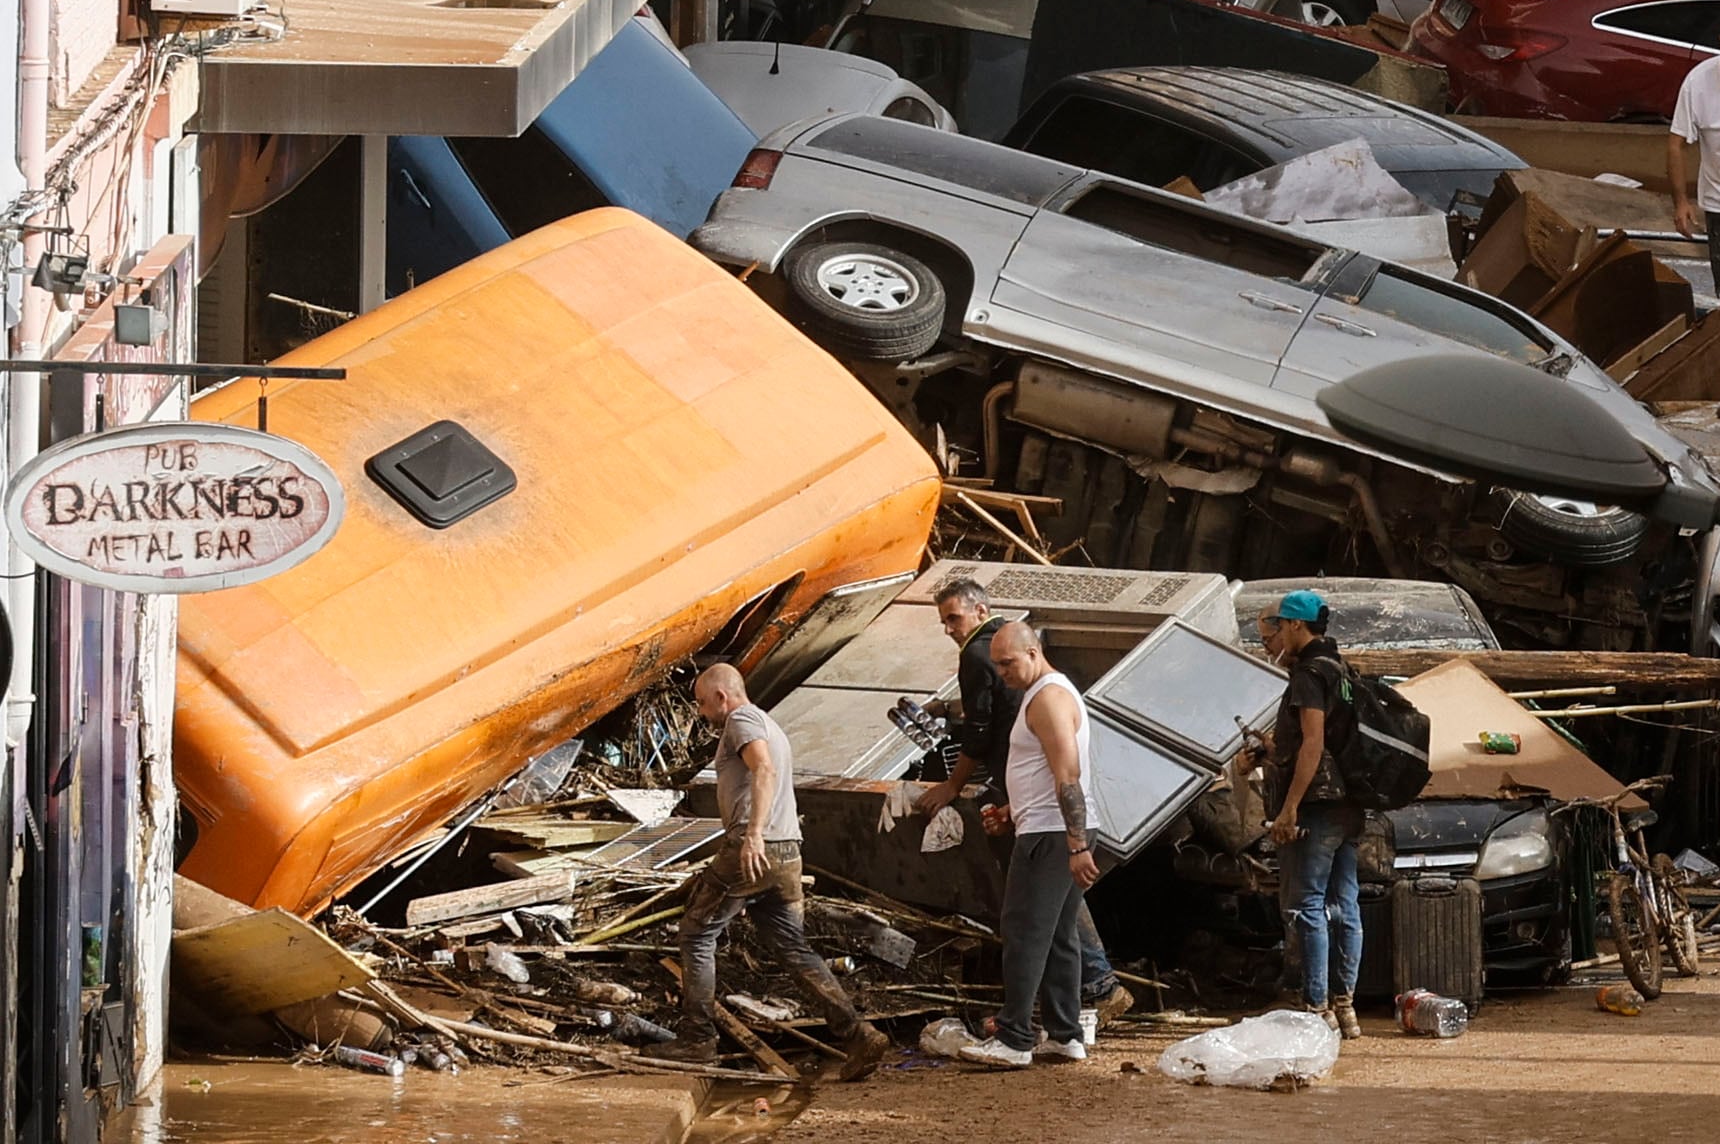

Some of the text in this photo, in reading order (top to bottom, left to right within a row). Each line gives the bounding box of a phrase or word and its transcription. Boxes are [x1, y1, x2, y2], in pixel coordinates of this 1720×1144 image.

[143, 442, 199, 473] PUB
[42, 475, 305, 525] DARKNESS
[87, 529, 256, 566] METAL BAR
